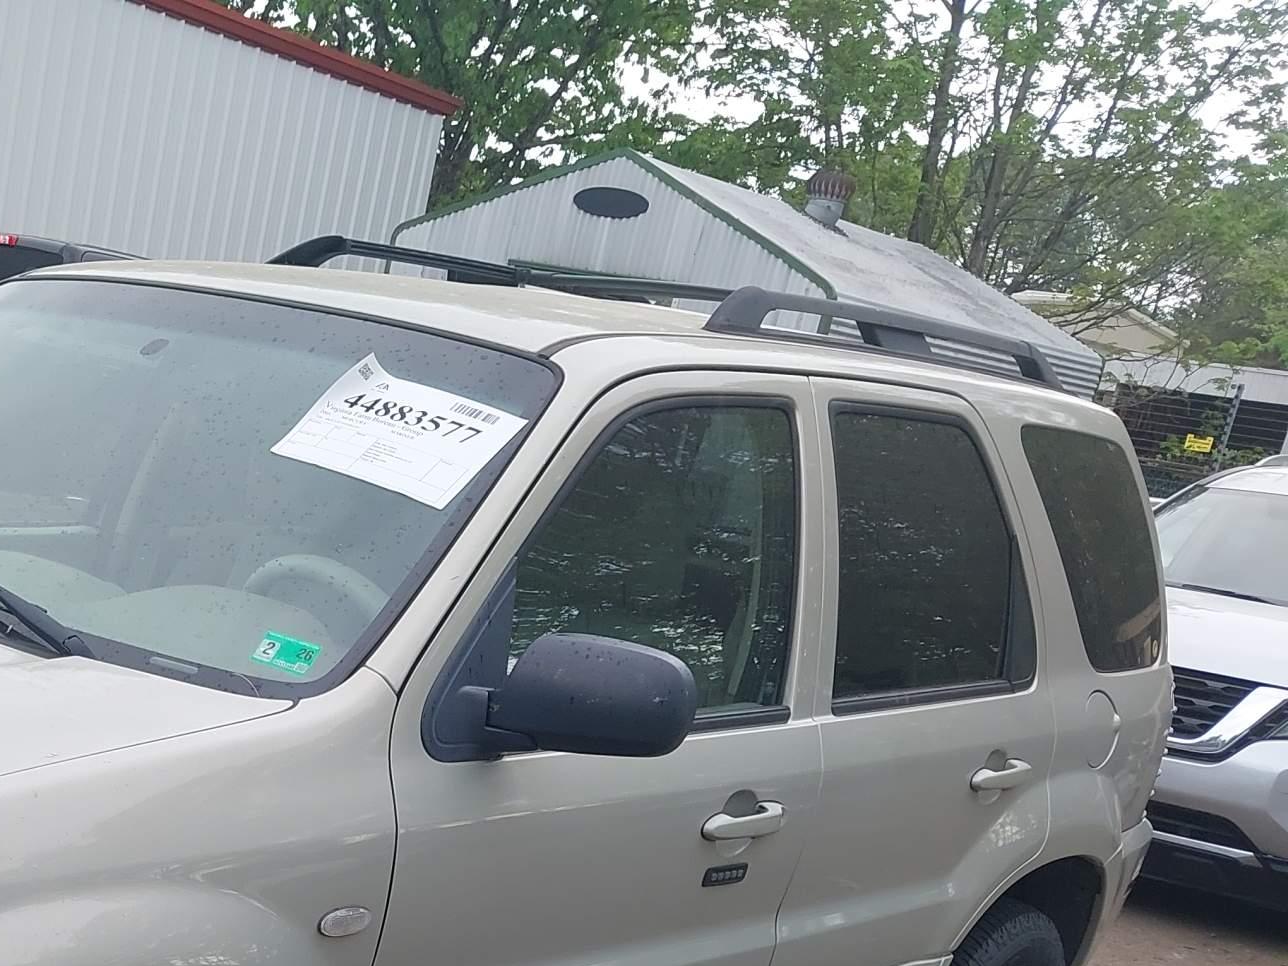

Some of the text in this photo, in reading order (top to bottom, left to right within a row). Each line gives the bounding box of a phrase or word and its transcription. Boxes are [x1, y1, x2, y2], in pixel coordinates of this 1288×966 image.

[343, 393, 484, 443] 44883577
[262, 641, 314, 662] 2 26
